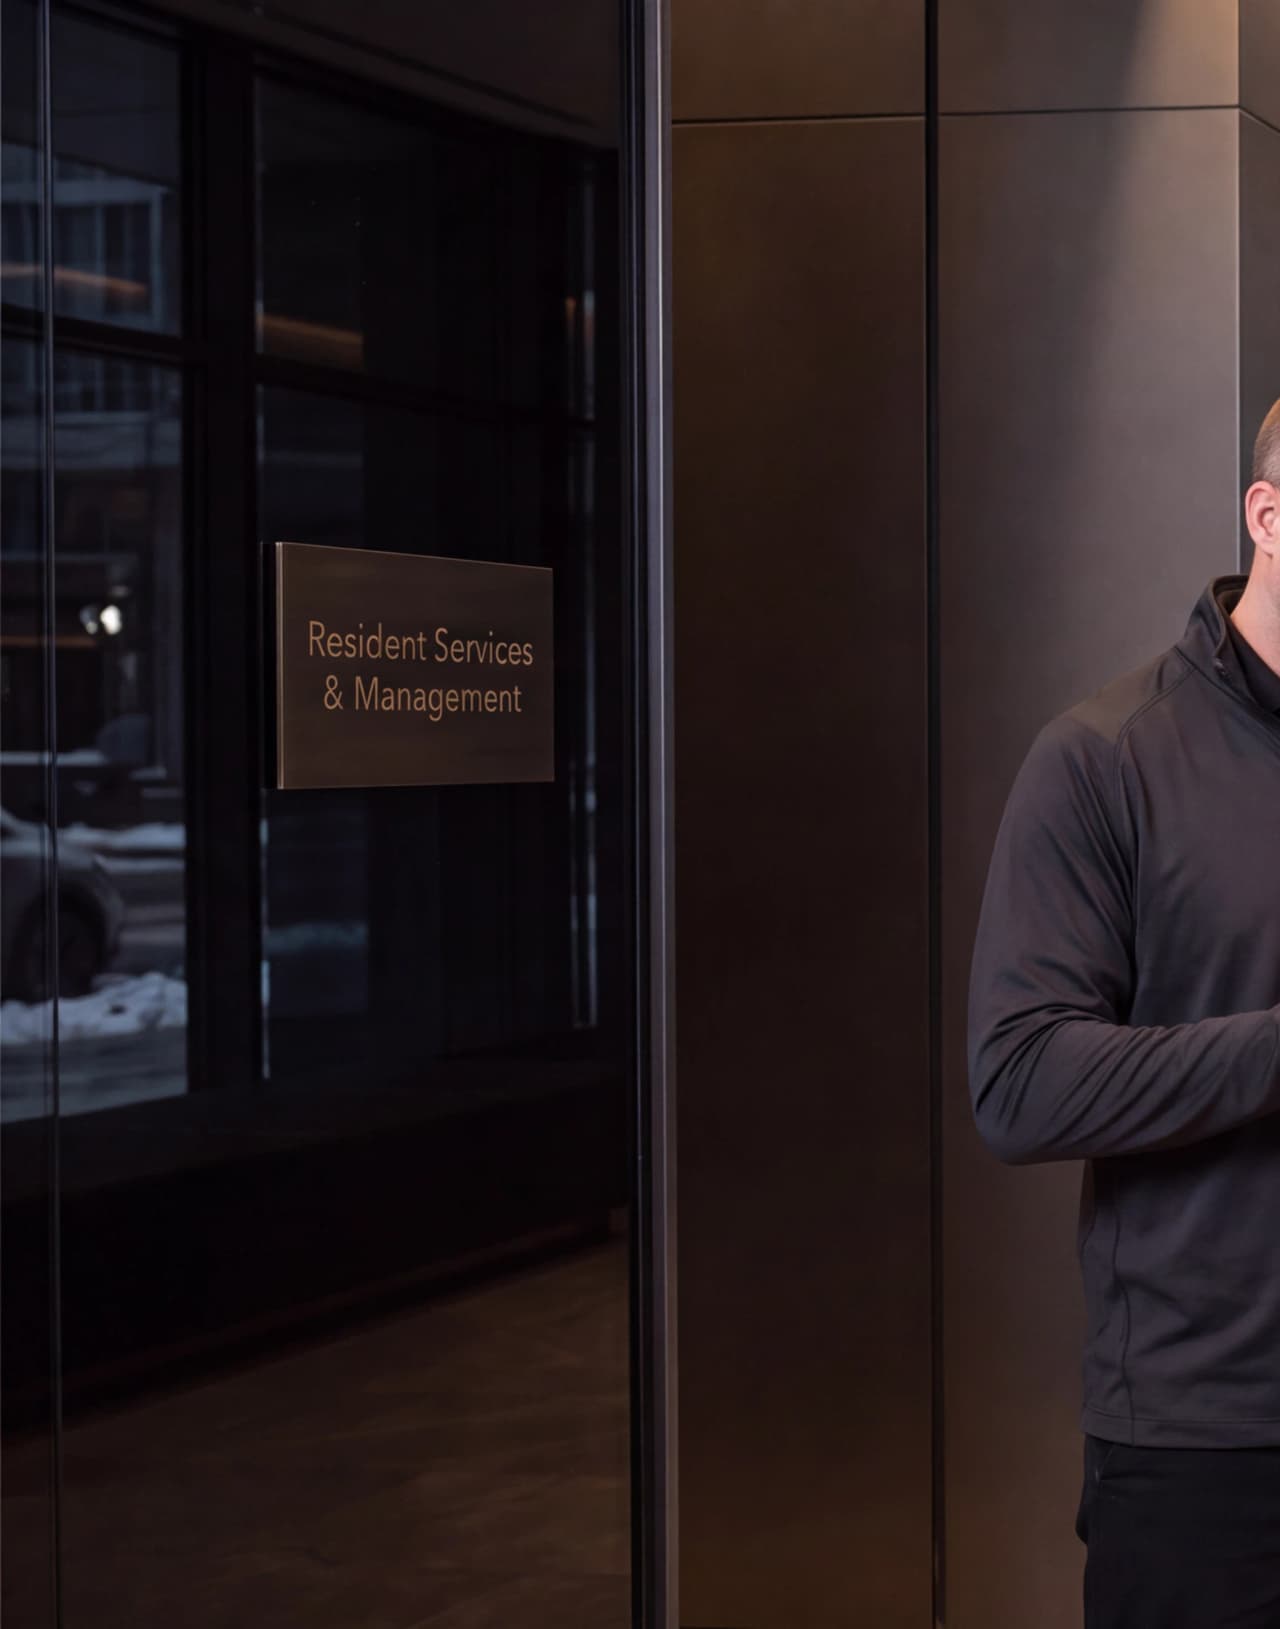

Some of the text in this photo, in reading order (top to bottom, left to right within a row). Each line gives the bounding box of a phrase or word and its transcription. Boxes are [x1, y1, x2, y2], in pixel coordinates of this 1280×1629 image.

[308, 620, 534, 666] Resident Services
[323, 674, 523, 722] & Management
